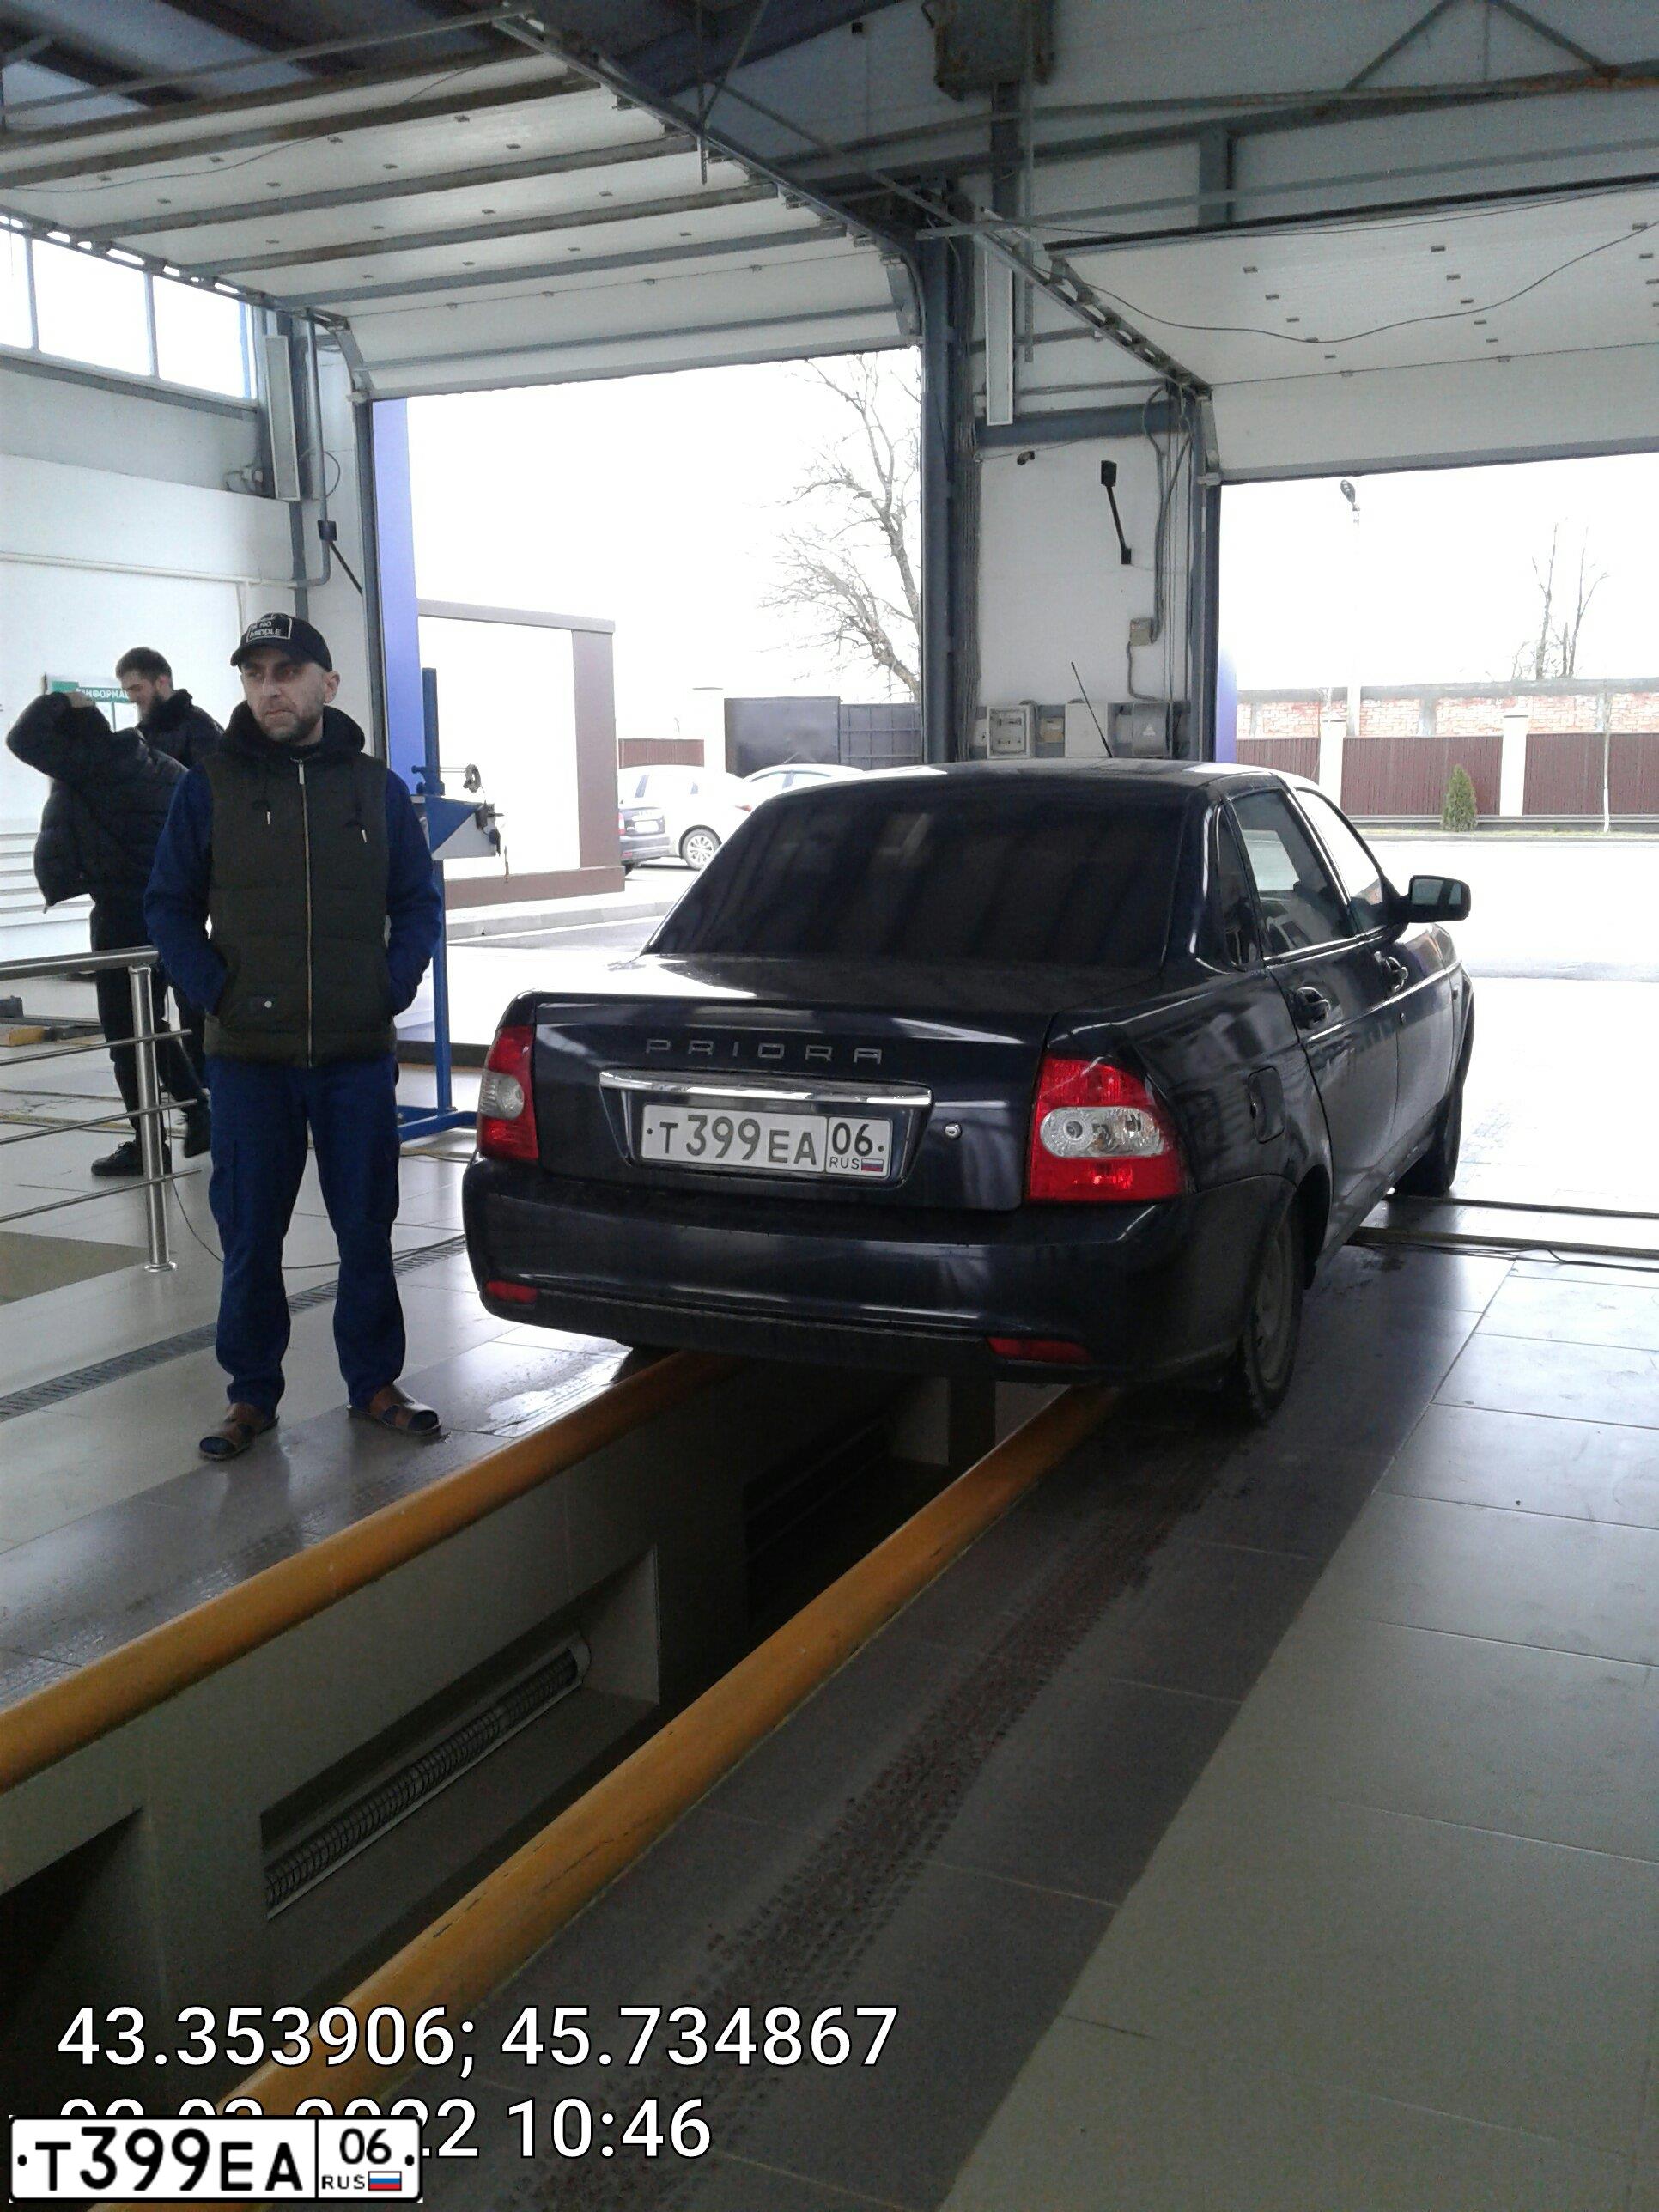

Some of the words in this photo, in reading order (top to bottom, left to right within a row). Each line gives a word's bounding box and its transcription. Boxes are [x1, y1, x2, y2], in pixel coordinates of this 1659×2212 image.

[645, 1038, 882, 1065] PRIORA
[659, 1114, 817, 1166] Т399ЕА
[832, 1121, 873, 1158] 06
[829, 1156, 860, 1170] RUS
